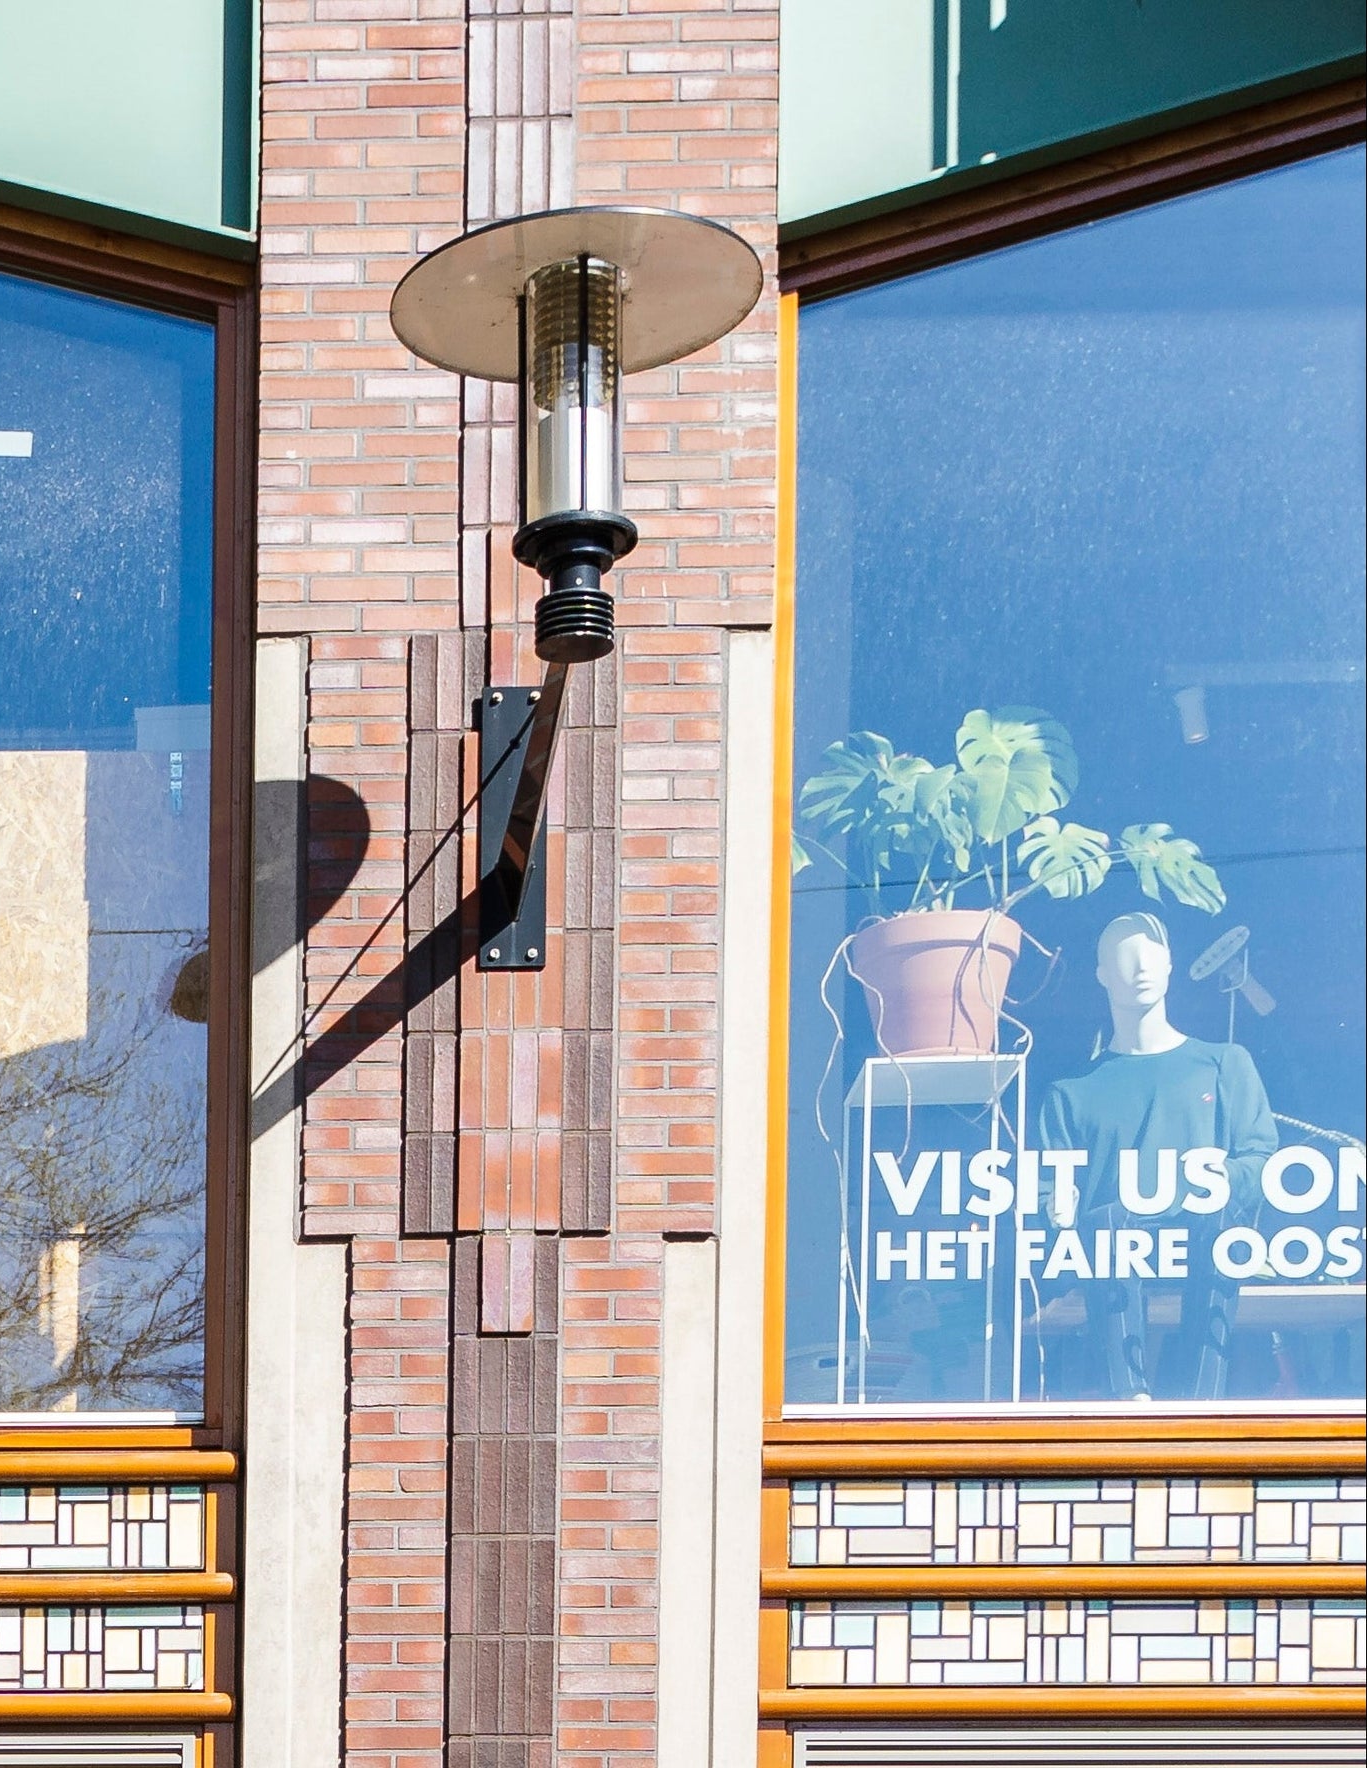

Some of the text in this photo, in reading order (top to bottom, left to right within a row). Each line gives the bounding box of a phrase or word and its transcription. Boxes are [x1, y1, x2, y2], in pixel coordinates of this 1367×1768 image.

[874, 1149, 1088, 1217] VISIT
[1118, 1146, 1232, 1215] US
[875, 1226, 1367, 1281] HET FAIRE OOS
